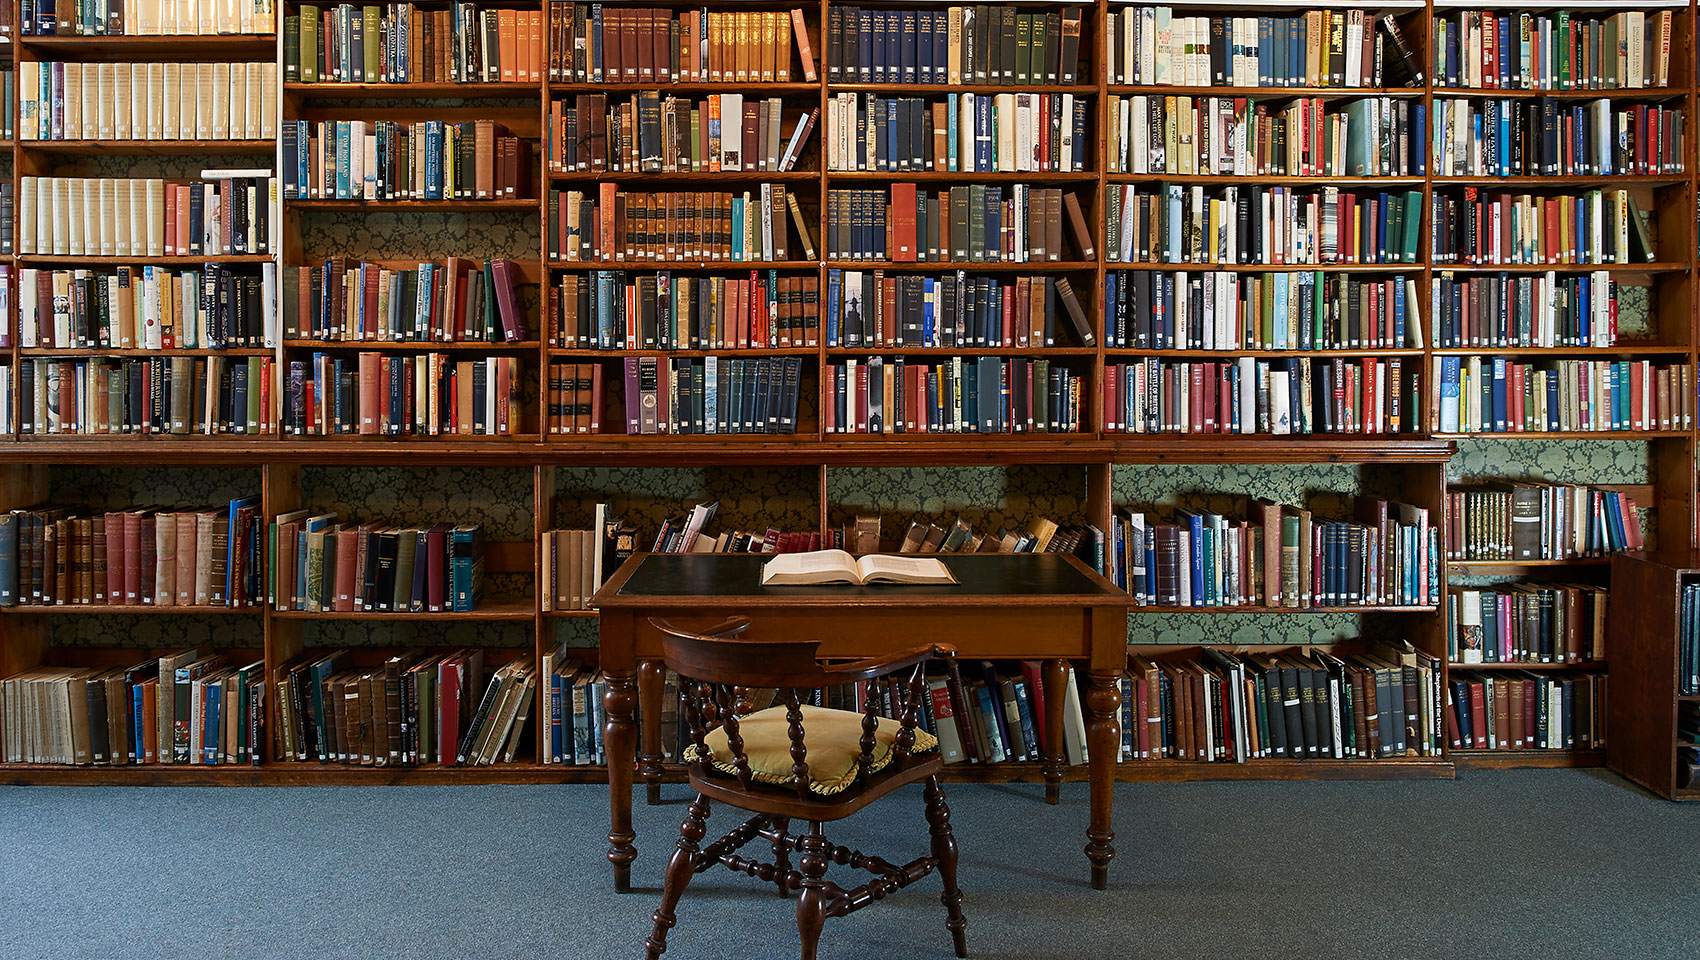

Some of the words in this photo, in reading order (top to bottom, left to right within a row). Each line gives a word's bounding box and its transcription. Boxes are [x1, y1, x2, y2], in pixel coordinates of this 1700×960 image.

[1484, 16, 1493, 49] ALAMEIN
[1663, 23, 1671, 41] COOLER
[1171, 122, 1176, 130] AT
